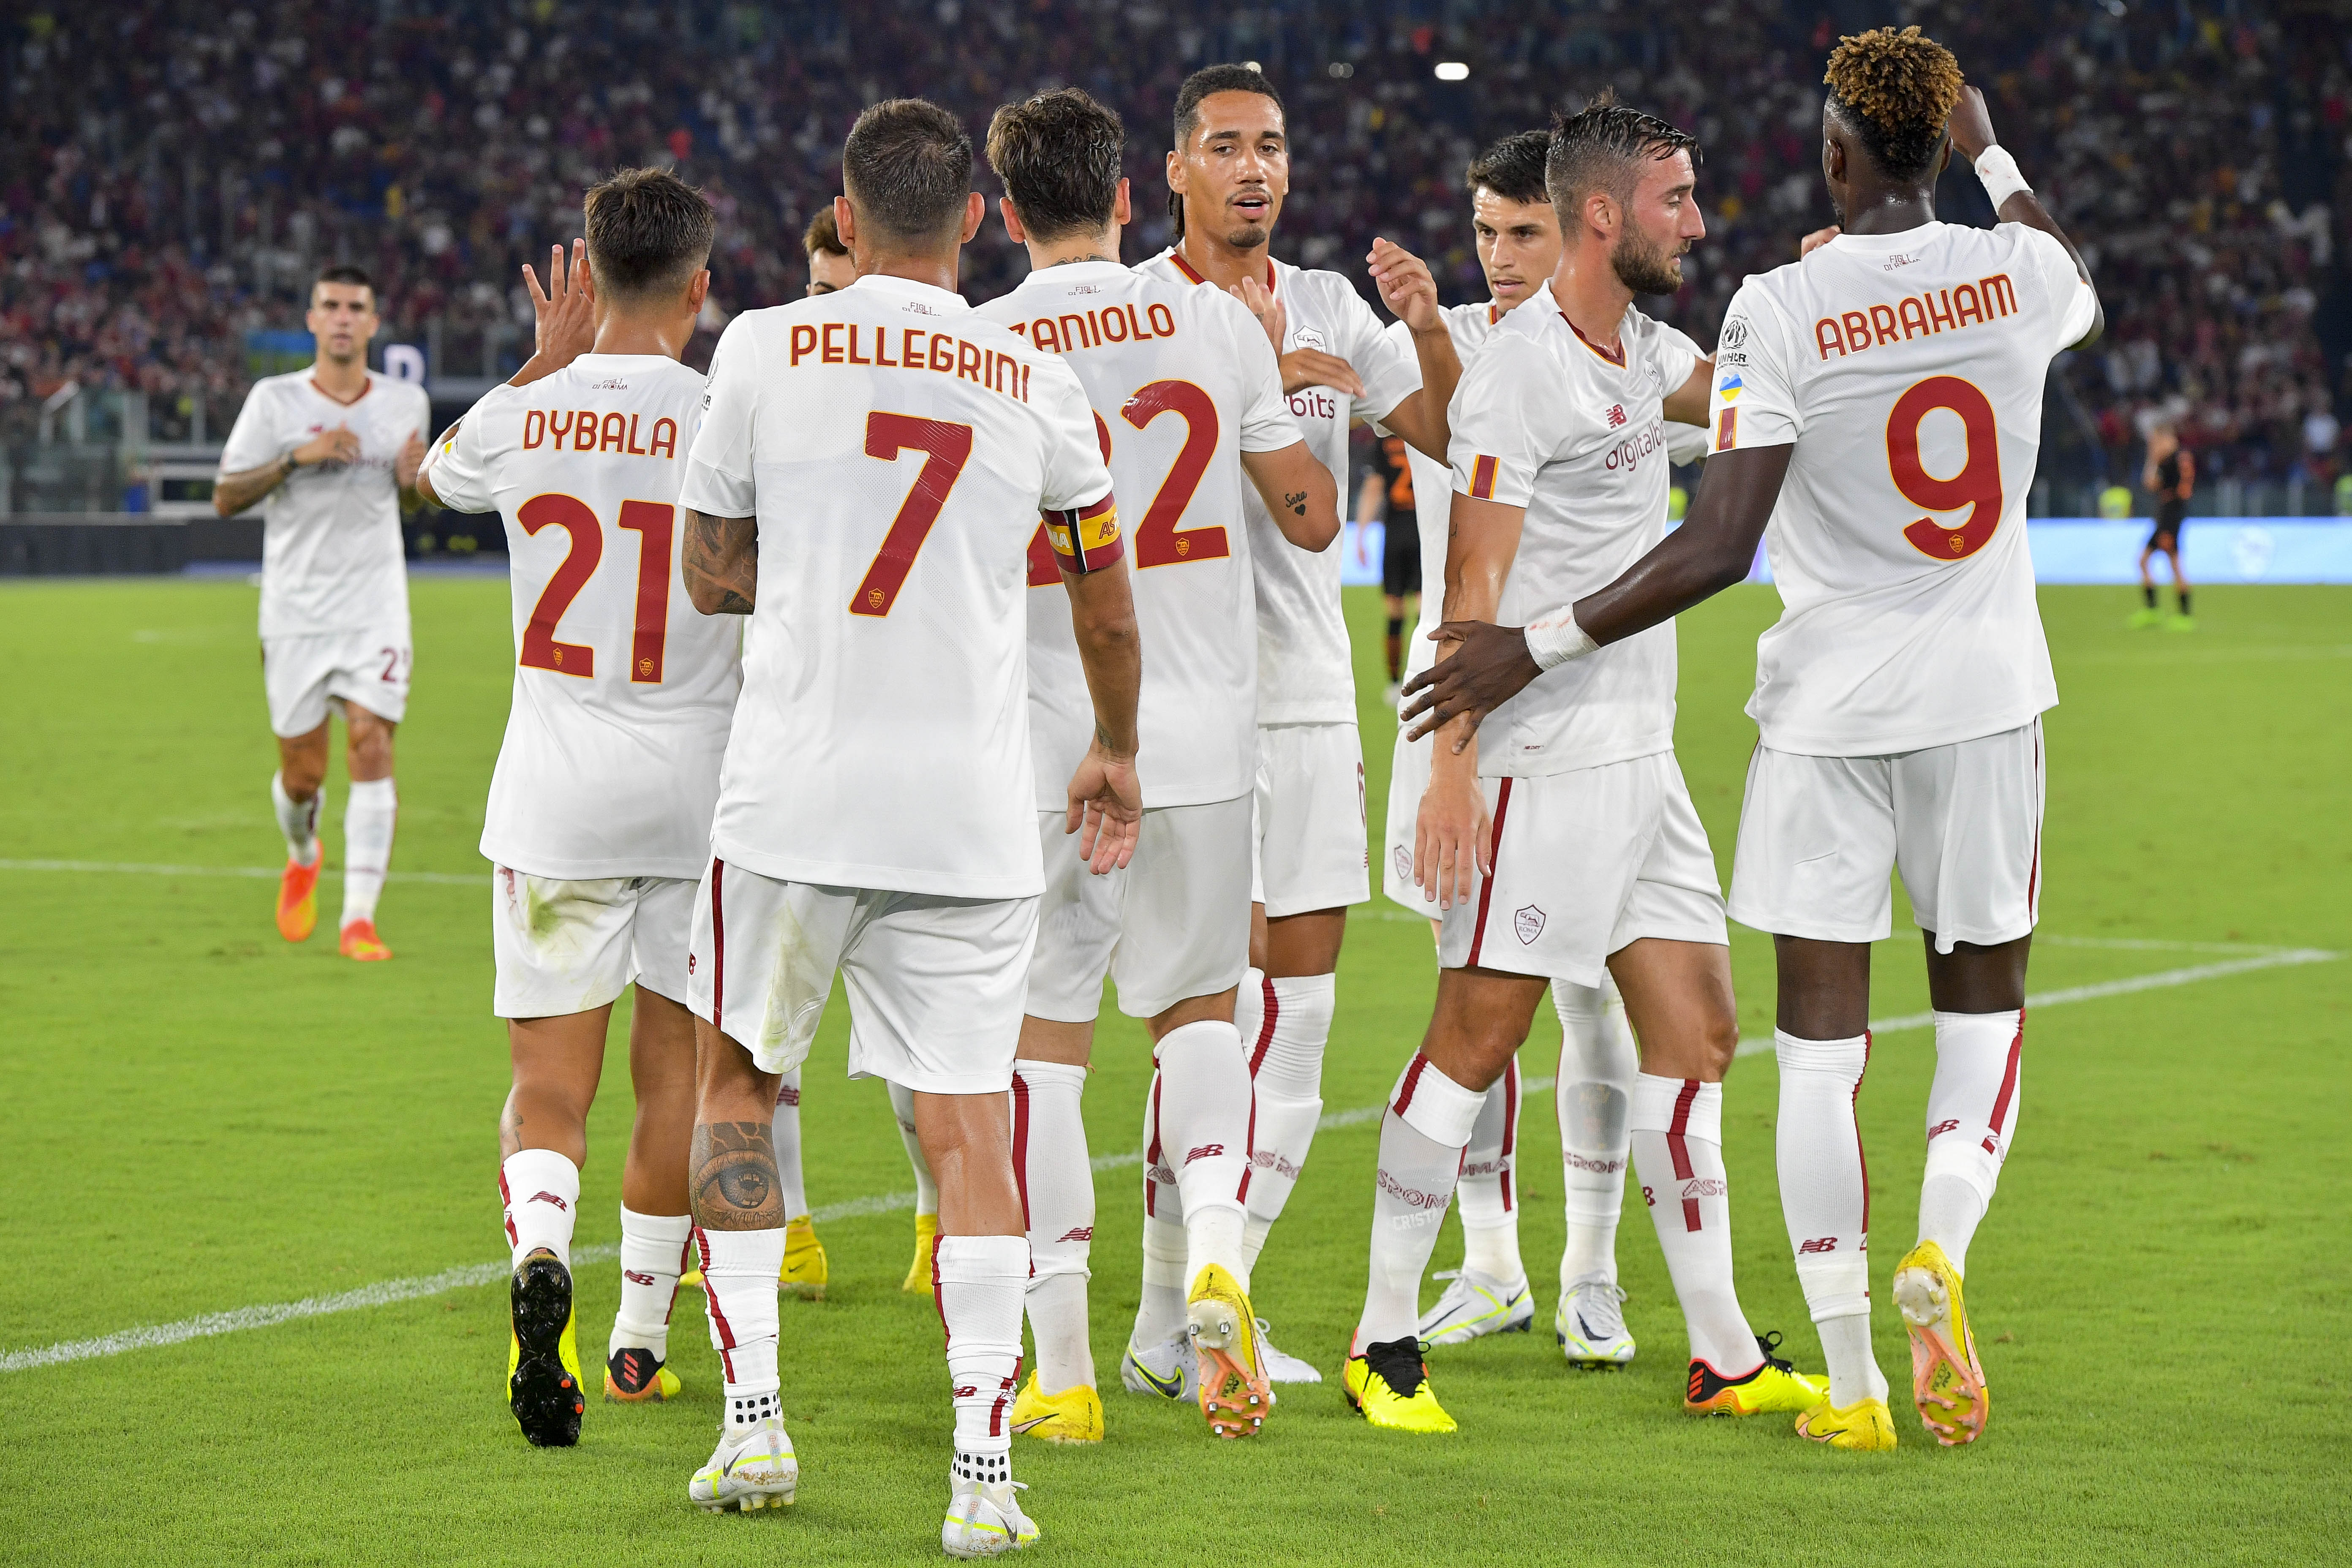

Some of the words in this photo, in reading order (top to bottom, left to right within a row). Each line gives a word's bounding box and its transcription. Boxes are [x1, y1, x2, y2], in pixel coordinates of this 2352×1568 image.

[1889, 254, 1909, 263] FIGLI
[910, 302, 932, 313] FIGLI
[1815, 274, 2017, 362] ABRAHAM
[790, 321, 1031, 403] PELLEGRINI
[1718, 353, 1747, 365] UNHCR
[523, 409, 677, 460] DYBALA
[1886, 375, 2003, 561] 9
[848, 410, 974, 618] 7
[1285, 491, 1307, 508] Sara
[516, 492, 675, 685] 21
[1519, 926, 1538, 934] ROMA
